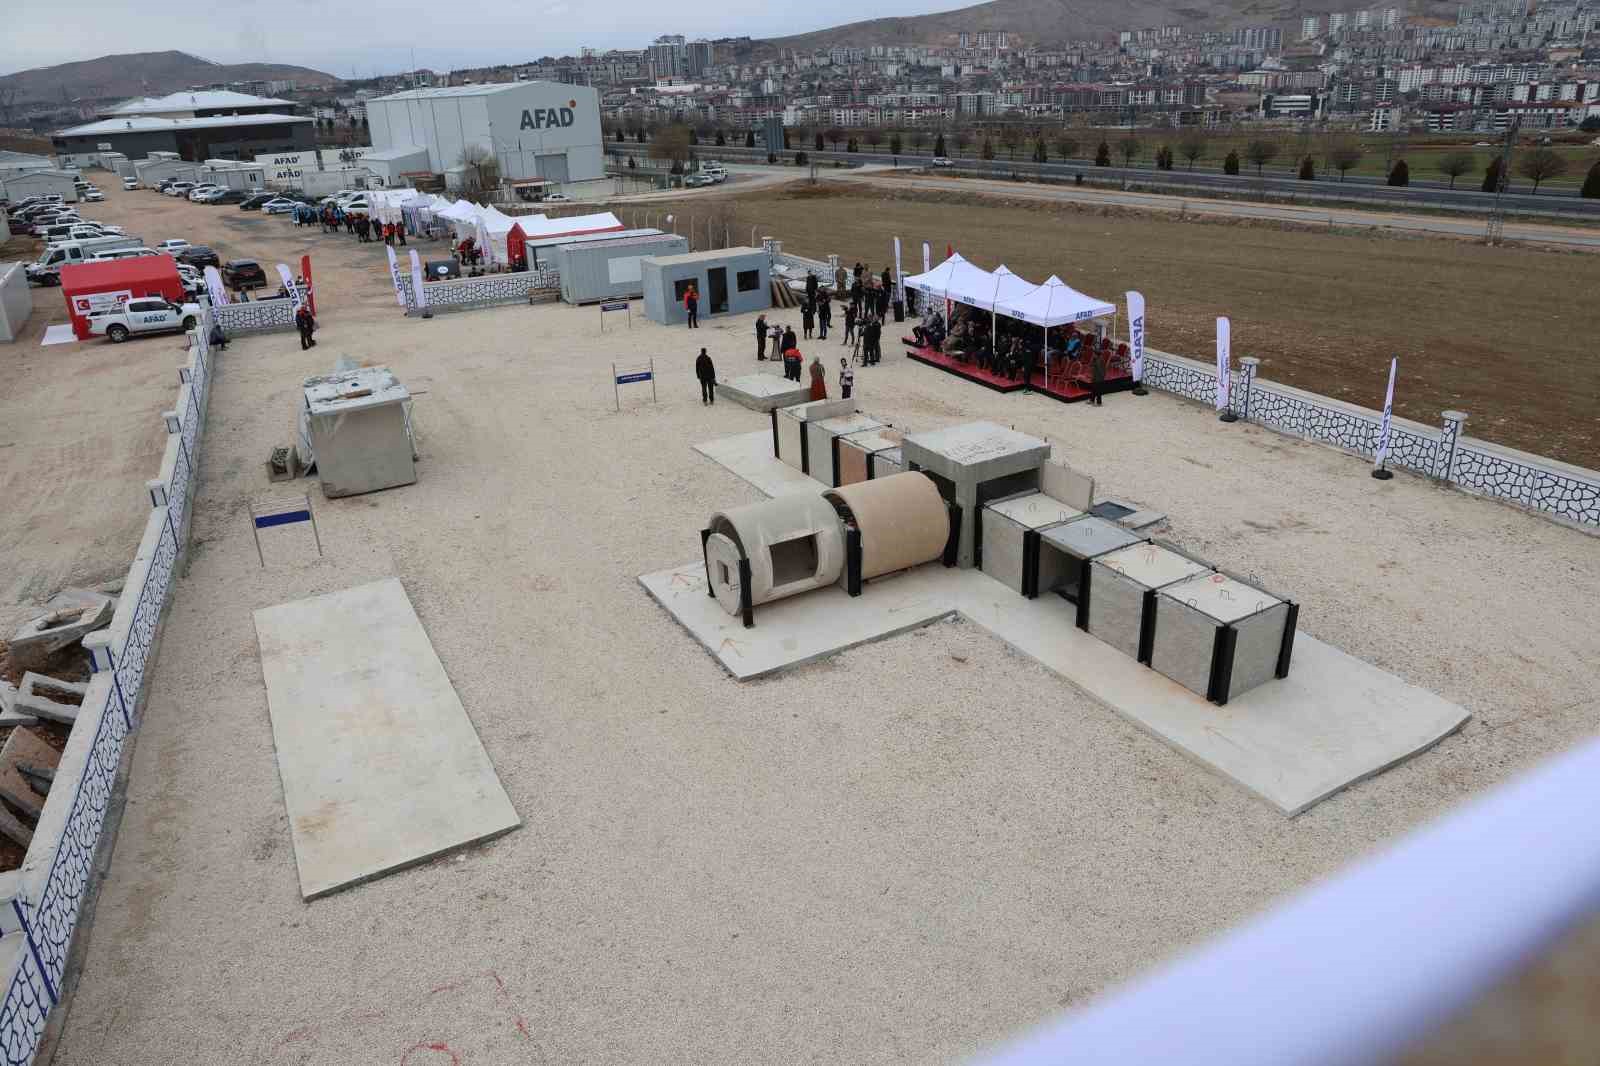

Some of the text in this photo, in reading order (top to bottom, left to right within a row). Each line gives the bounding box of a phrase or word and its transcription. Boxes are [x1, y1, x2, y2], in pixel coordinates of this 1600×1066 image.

[520, 107, 574, 130] AFAD
[274, 156, 298, 165] AFAD
[277, 170, 301, 179] AFAD
[143, 315, 166, 323] AFAD
[1076, 311, 1093, 321] AFAD
